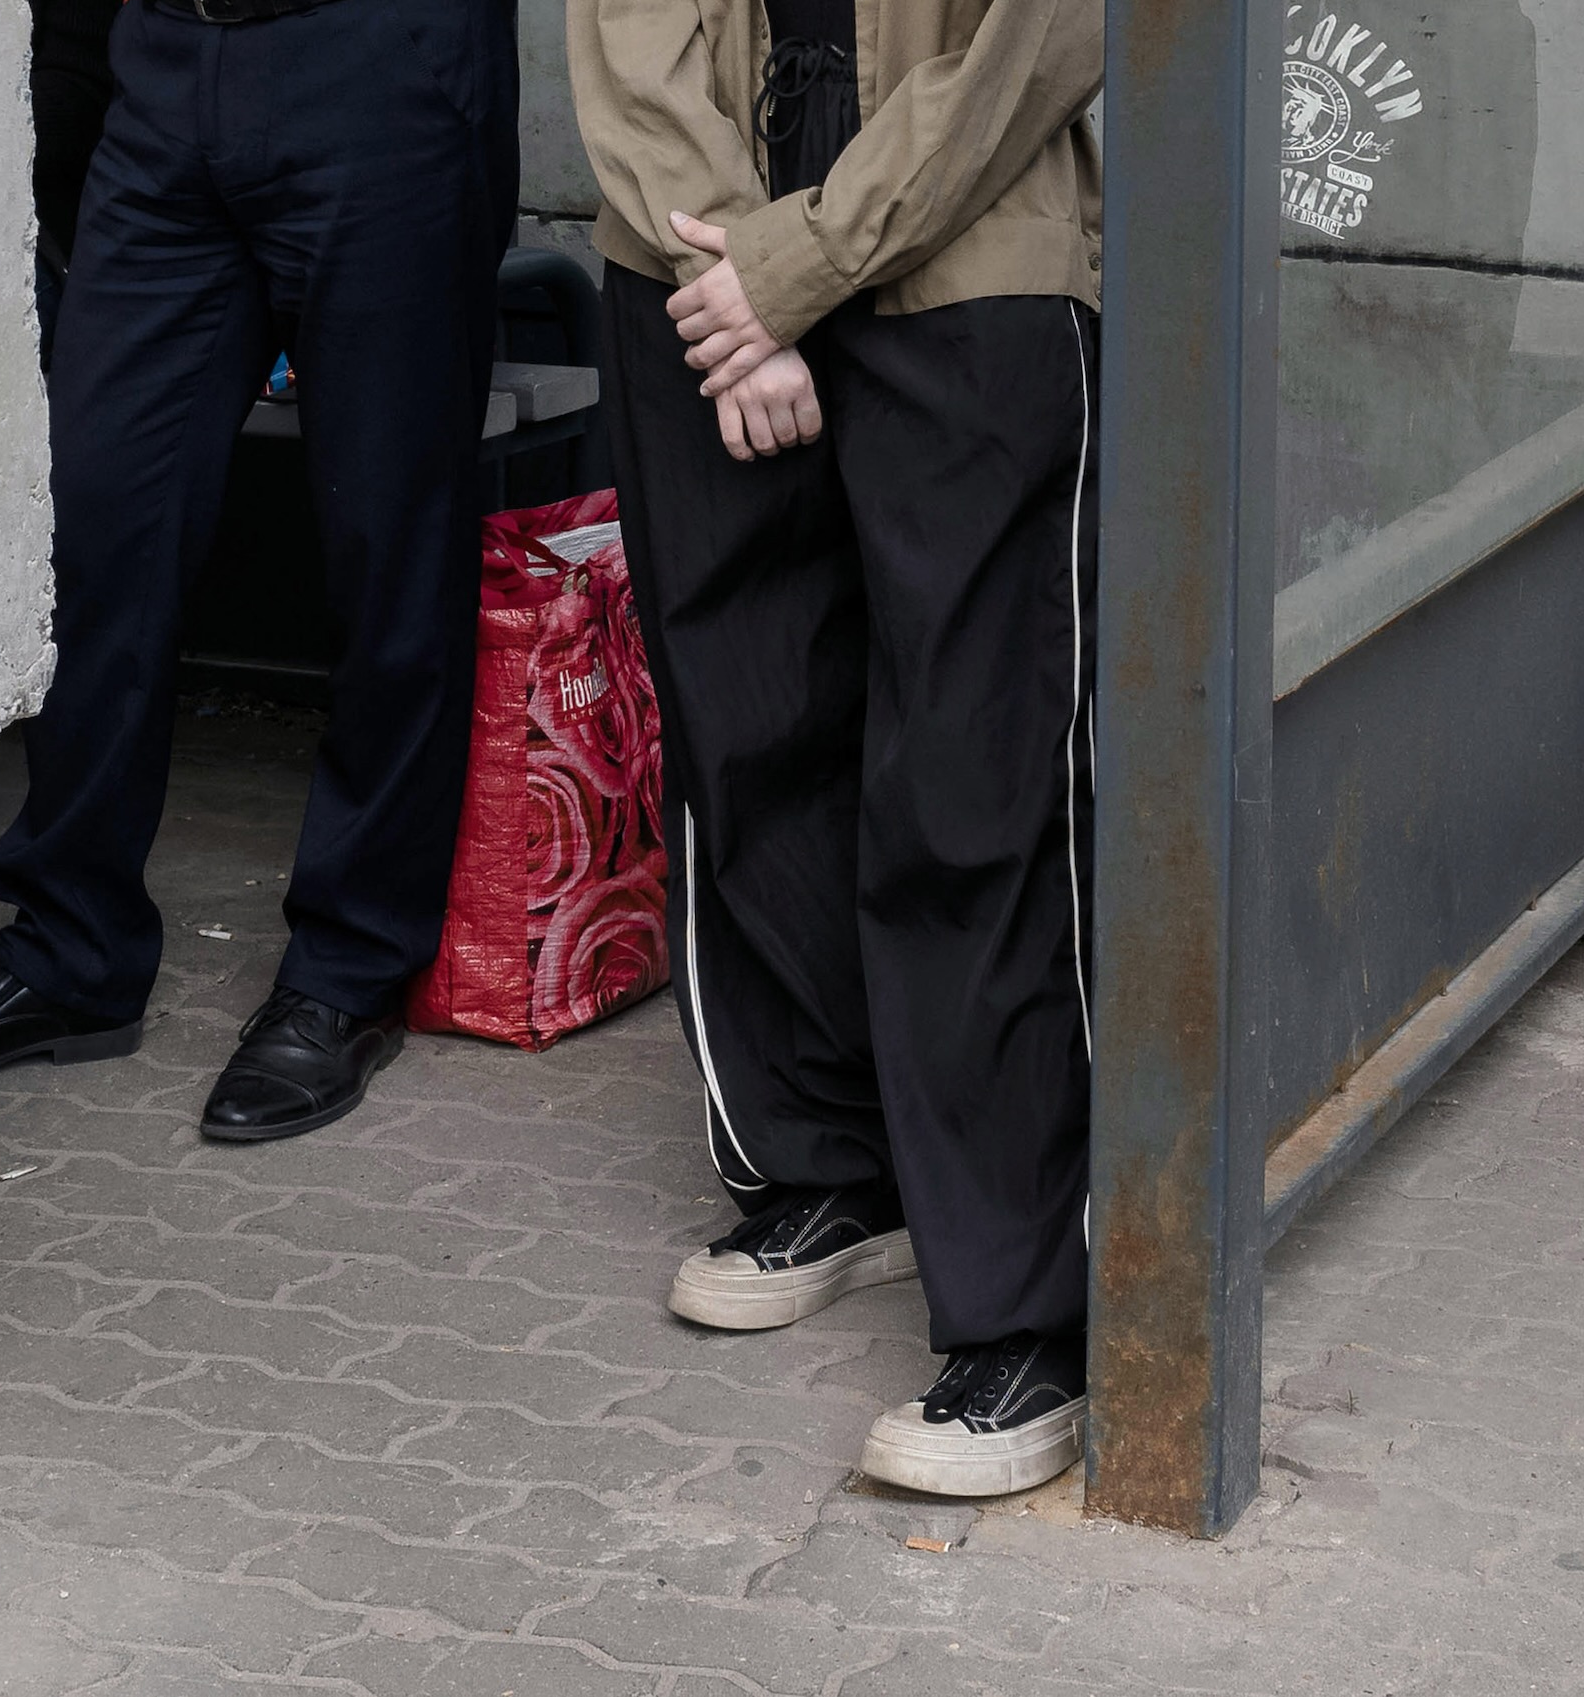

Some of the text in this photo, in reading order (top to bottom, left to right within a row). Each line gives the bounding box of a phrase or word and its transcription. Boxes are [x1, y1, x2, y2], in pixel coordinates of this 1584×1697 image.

[1300, 66, 1321, 79] CITY
[1322, 76, 1340, 95] EAST
[1336, 98, 1347, 126] COAST
[1331, 167, 1368, 187] COAST
